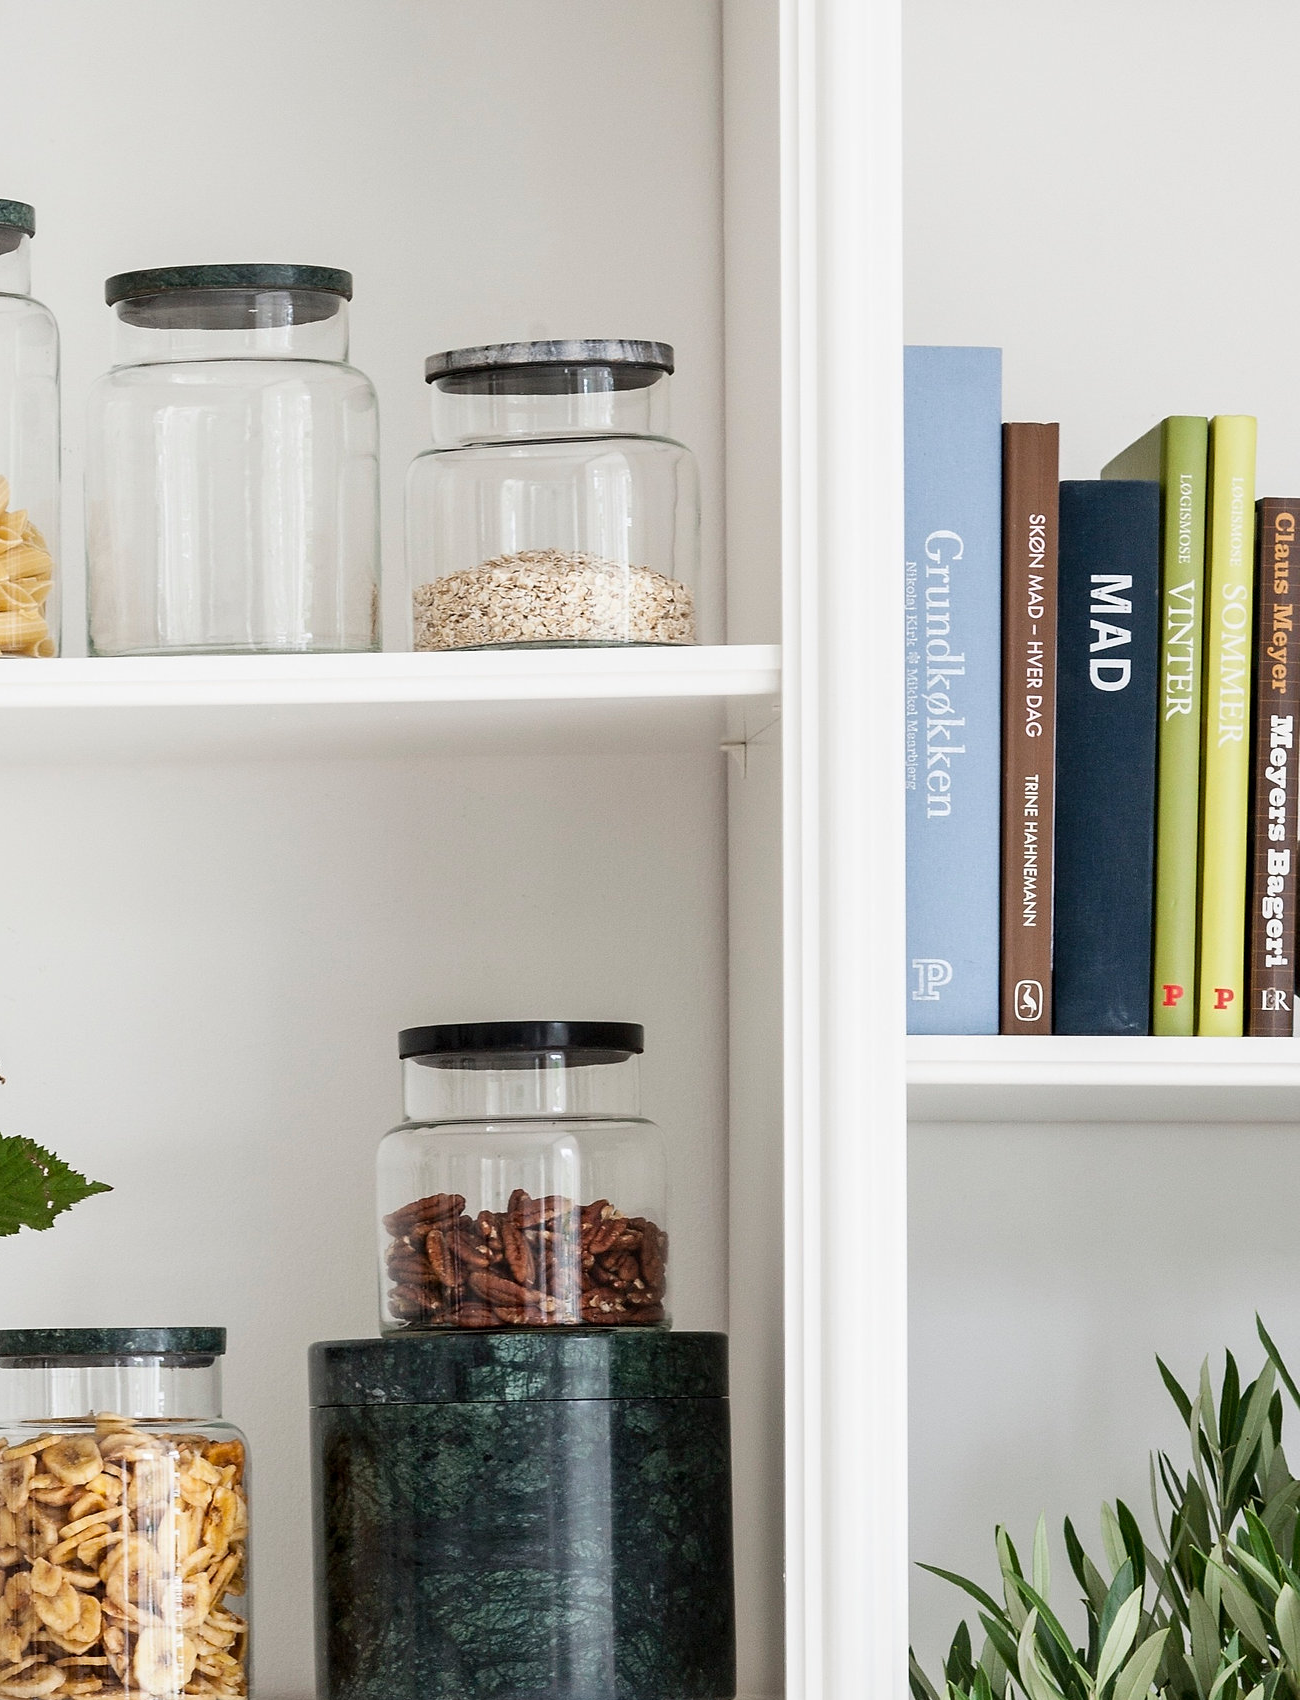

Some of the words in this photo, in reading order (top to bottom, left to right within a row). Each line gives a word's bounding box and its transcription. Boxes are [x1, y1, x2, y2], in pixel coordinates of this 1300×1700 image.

[1028, 513, 1046, 568] SKØN
[1179, 474, 1193, 564] LØGISMOSE
[1229, 477, 1244, 568] LØGISMOSE
[1274, 511, 1295, 594] Claus
[906, 615, 918, 647] Kirk
[1027, 576, 1045, 619] MAD
[1089, 574, 1133, 692] MAD
[922, 530, 965, 818] Grundkøkken
[1027, 641, 1044, 690] HVER
[1166, 579, 1195, 721] VINTER
[1218, 583, 1247, 748] SOMMER
[1267, 603, 1294, 694] Meyer
[906, 668, 918, 716] Mikkel
[1025, 695, 1043, 737] DAG
[1025, 774, 1039, 817] TRINE
[1266, 714, 1294, 843] Meyers
[1023, 821, 1038, 927] HAHNEMANN
[1263, 848, 1290, 967] Bageri
[1162, 985, 1184, 1006] P
[1213, 988, 1234, 1009] P
